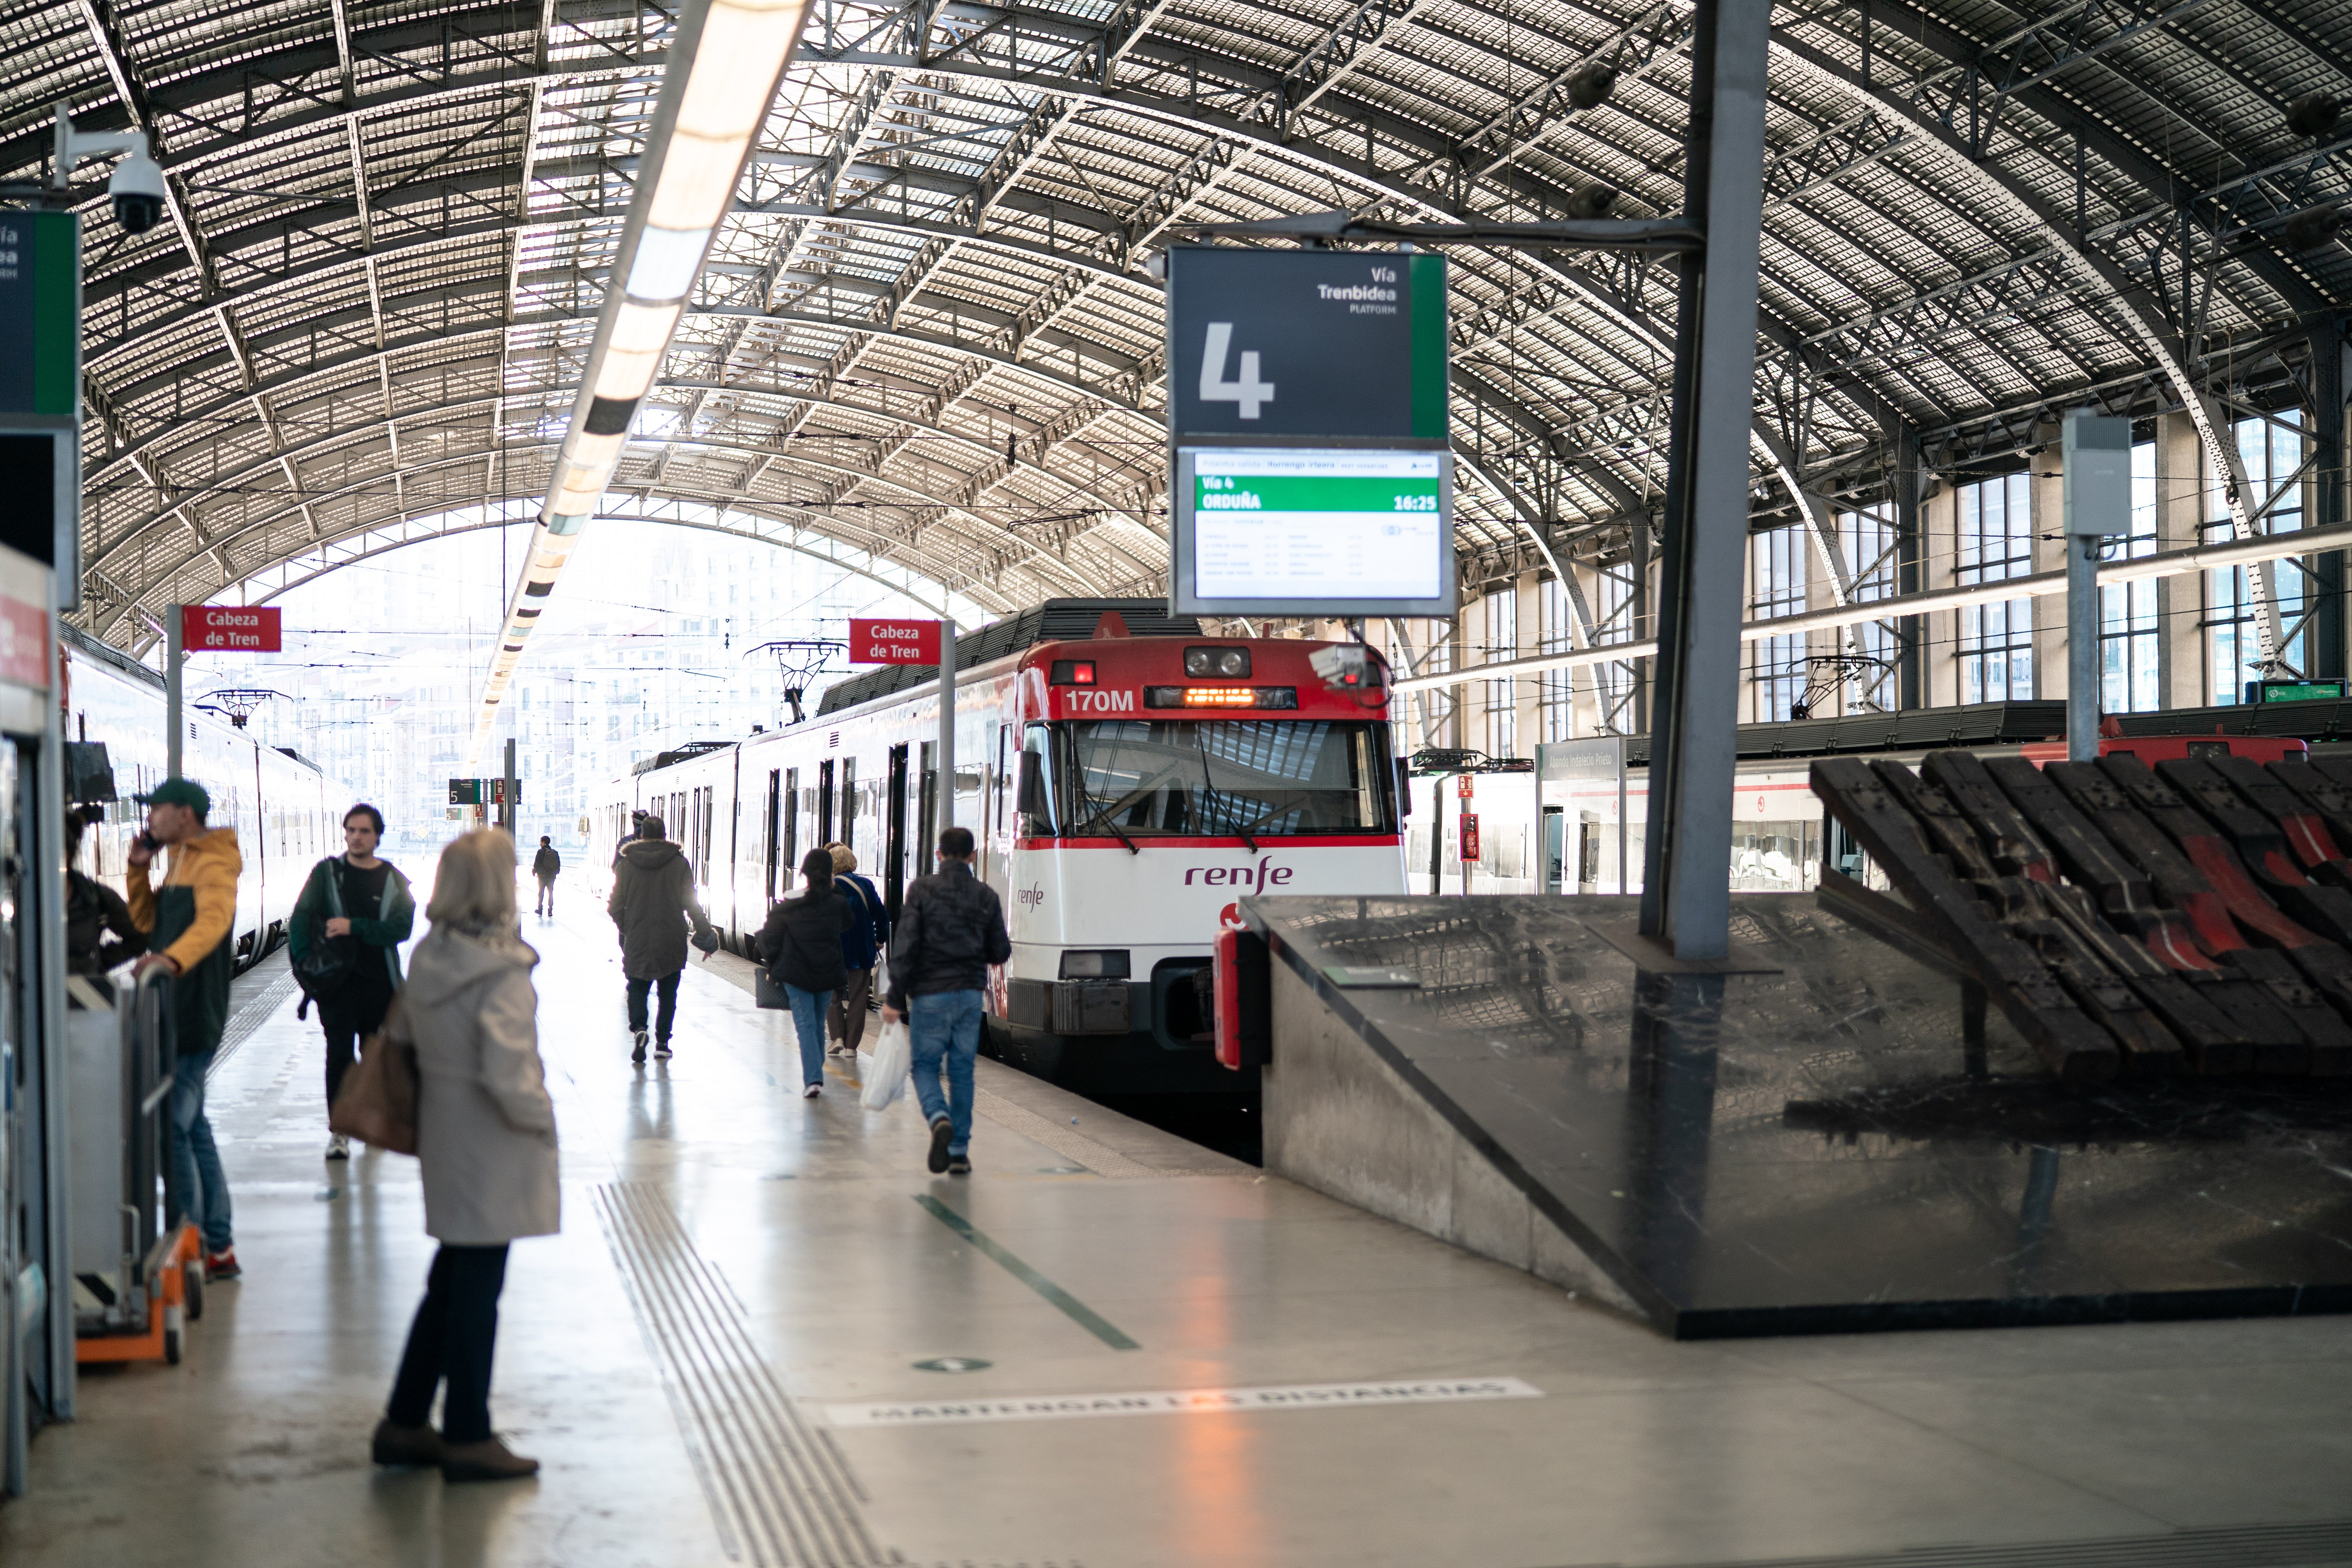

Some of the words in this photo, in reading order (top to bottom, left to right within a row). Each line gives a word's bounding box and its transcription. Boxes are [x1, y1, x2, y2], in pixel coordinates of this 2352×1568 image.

[1372, 267, 1396, 282] Vía
[1318, 284, 1396, 301] Trenbidea
[1350, 303, 1396, 314] PLATFORM
[1200, 322, 1275, 419] 4
[1202, 476, 1223, 490] Vía
[1224, 476, 1234, 490] 4
[1203, 491, 1262, 509] ORDUÑA
[1394, 495, 1437, 510] 16:25
[206, 612, 259, 626] Cabeza
[205, 632, 224, 645] de
[228, 632, 260, 646] Tren
[871, 625, 919, 639] Cabeza
[870, 644, 887, 657] de
[890, 645, 919, 658] Tren
[1066, 690, 1134, 711] 170M
[1550, 755, 1568, 768] Abando
[1570, 753, 1593, 767] Indalecio
[1595, 751, 1612, 765] Prieto
[451, 791, 458, 803] 5
[1185, 855, 1293, 896] renfe
[1017, 881, 1044, 913] renfe
[871, 1398, 1149, 1419] MANTENGAN
[1166, 1394, 1242, 1406] LAS
[1258, 1381, 1506, 1403] DISTANCIAS
